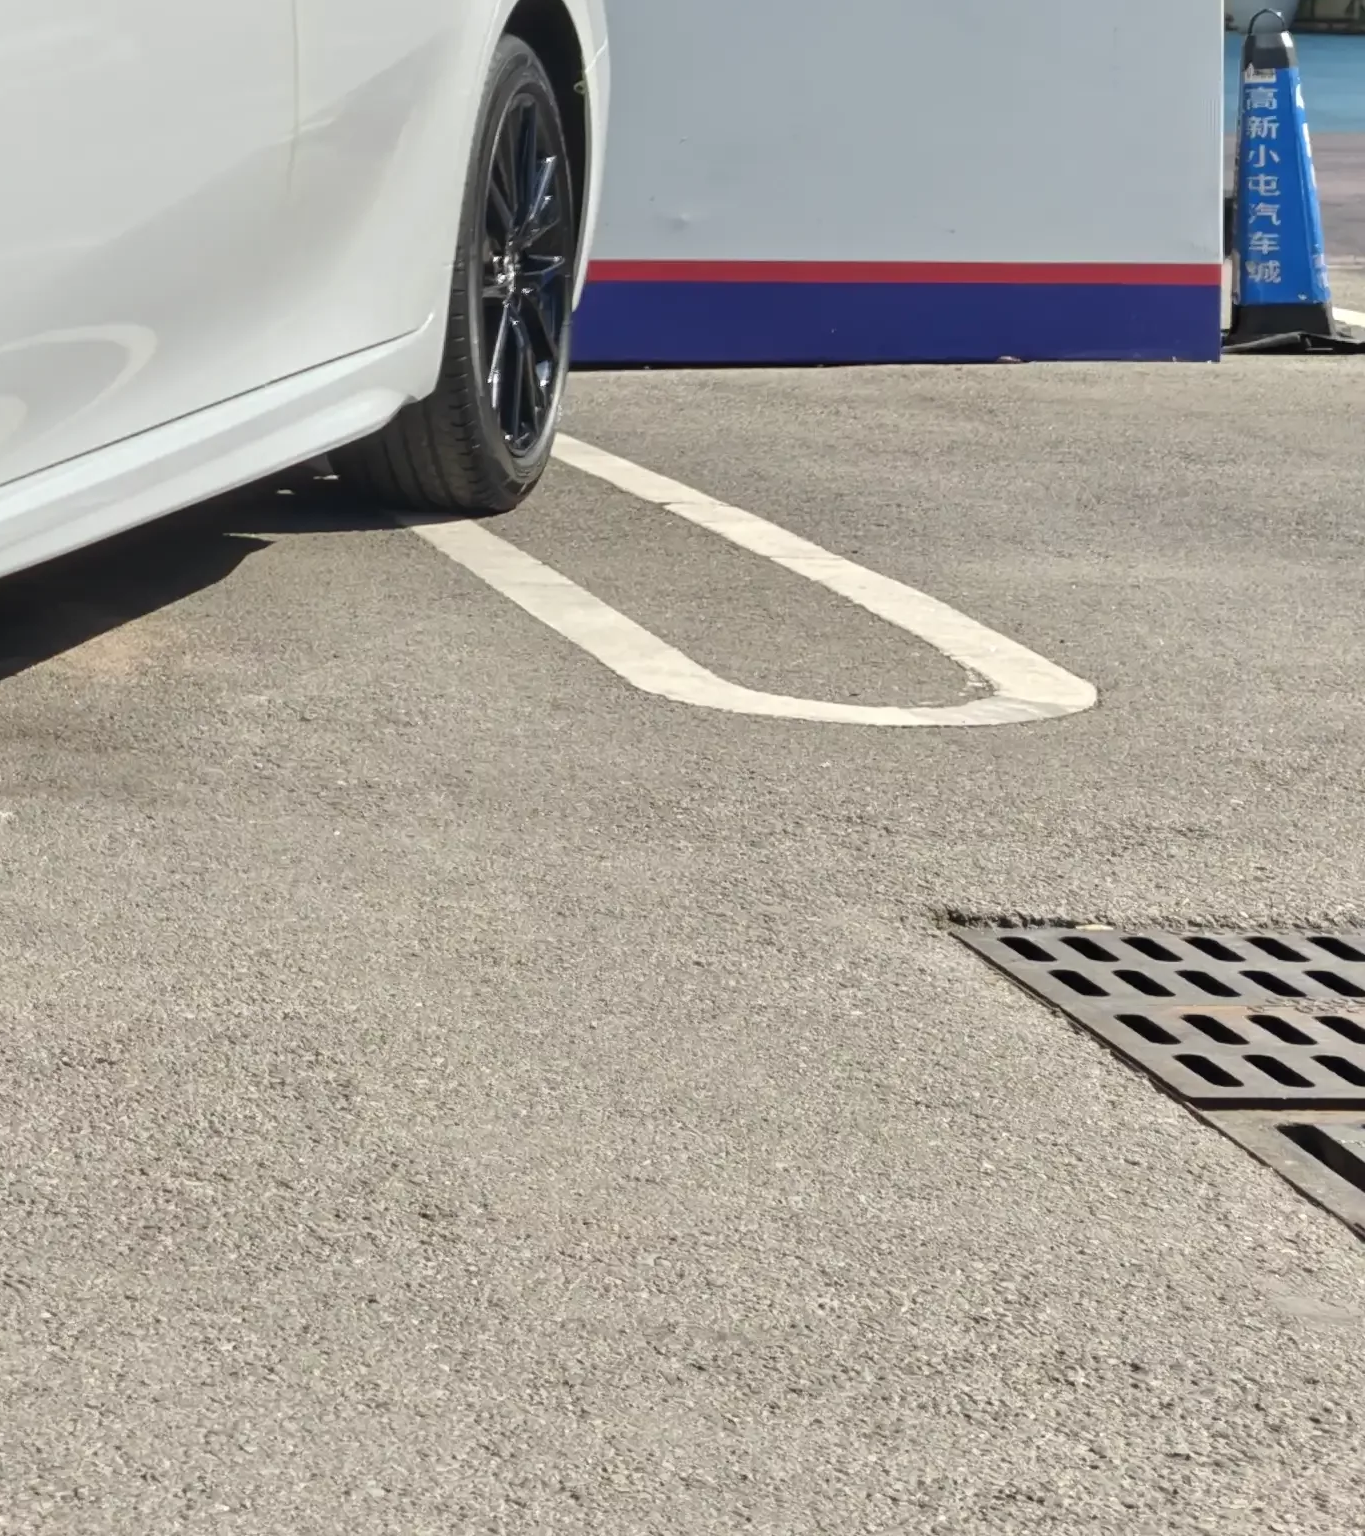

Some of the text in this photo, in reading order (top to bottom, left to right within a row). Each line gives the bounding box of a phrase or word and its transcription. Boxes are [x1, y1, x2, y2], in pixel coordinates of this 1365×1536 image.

[1244, 86, 1282, 284] 高新小屯汽车城
